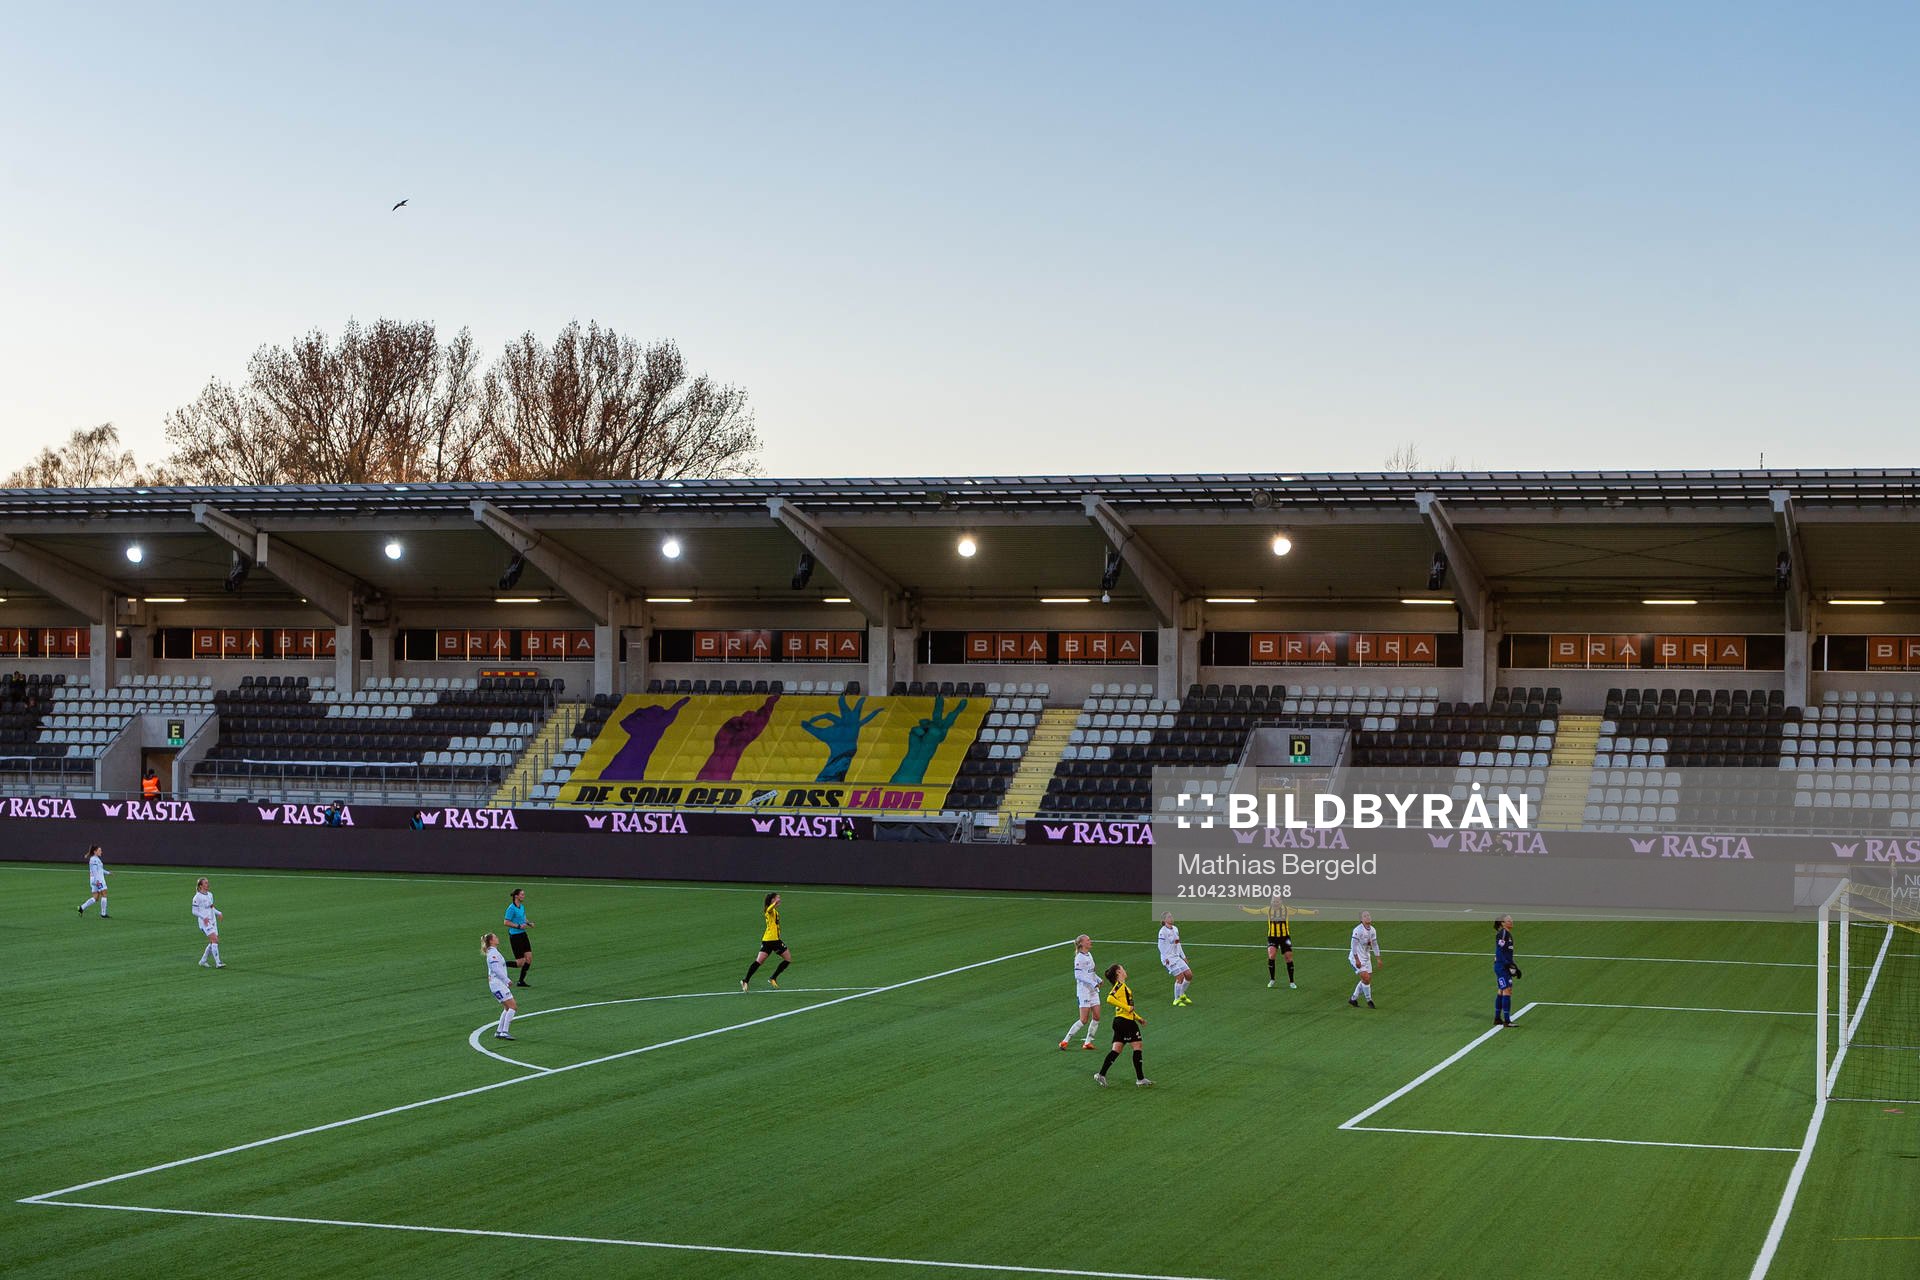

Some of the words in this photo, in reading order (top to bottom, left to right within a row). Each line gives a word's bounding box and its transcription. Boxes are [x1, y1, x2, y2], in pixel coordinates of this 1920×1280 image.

[171, 724, 180, 738] E
[1294, 740, 1306, 755] D
[572, 786, 613, 805] DE
[614, 787, 683, 806] SOM
[783, 789, 844, 808] OSS
[10, 798, 77, 819] RASTA
[126, 800, 196, 822] RASTA
[282, 804, 355, 826] RASA
[444, 808, 518, 830] RASTA
[611, 812, 688, 834] RASTA
[778, 815, 855, 838] RAST
[1072, 822, 1157, 845] RASTA
[1263, 826, 1350, 850] RASTA
[1661, 835, 1754, 859] RASTA
